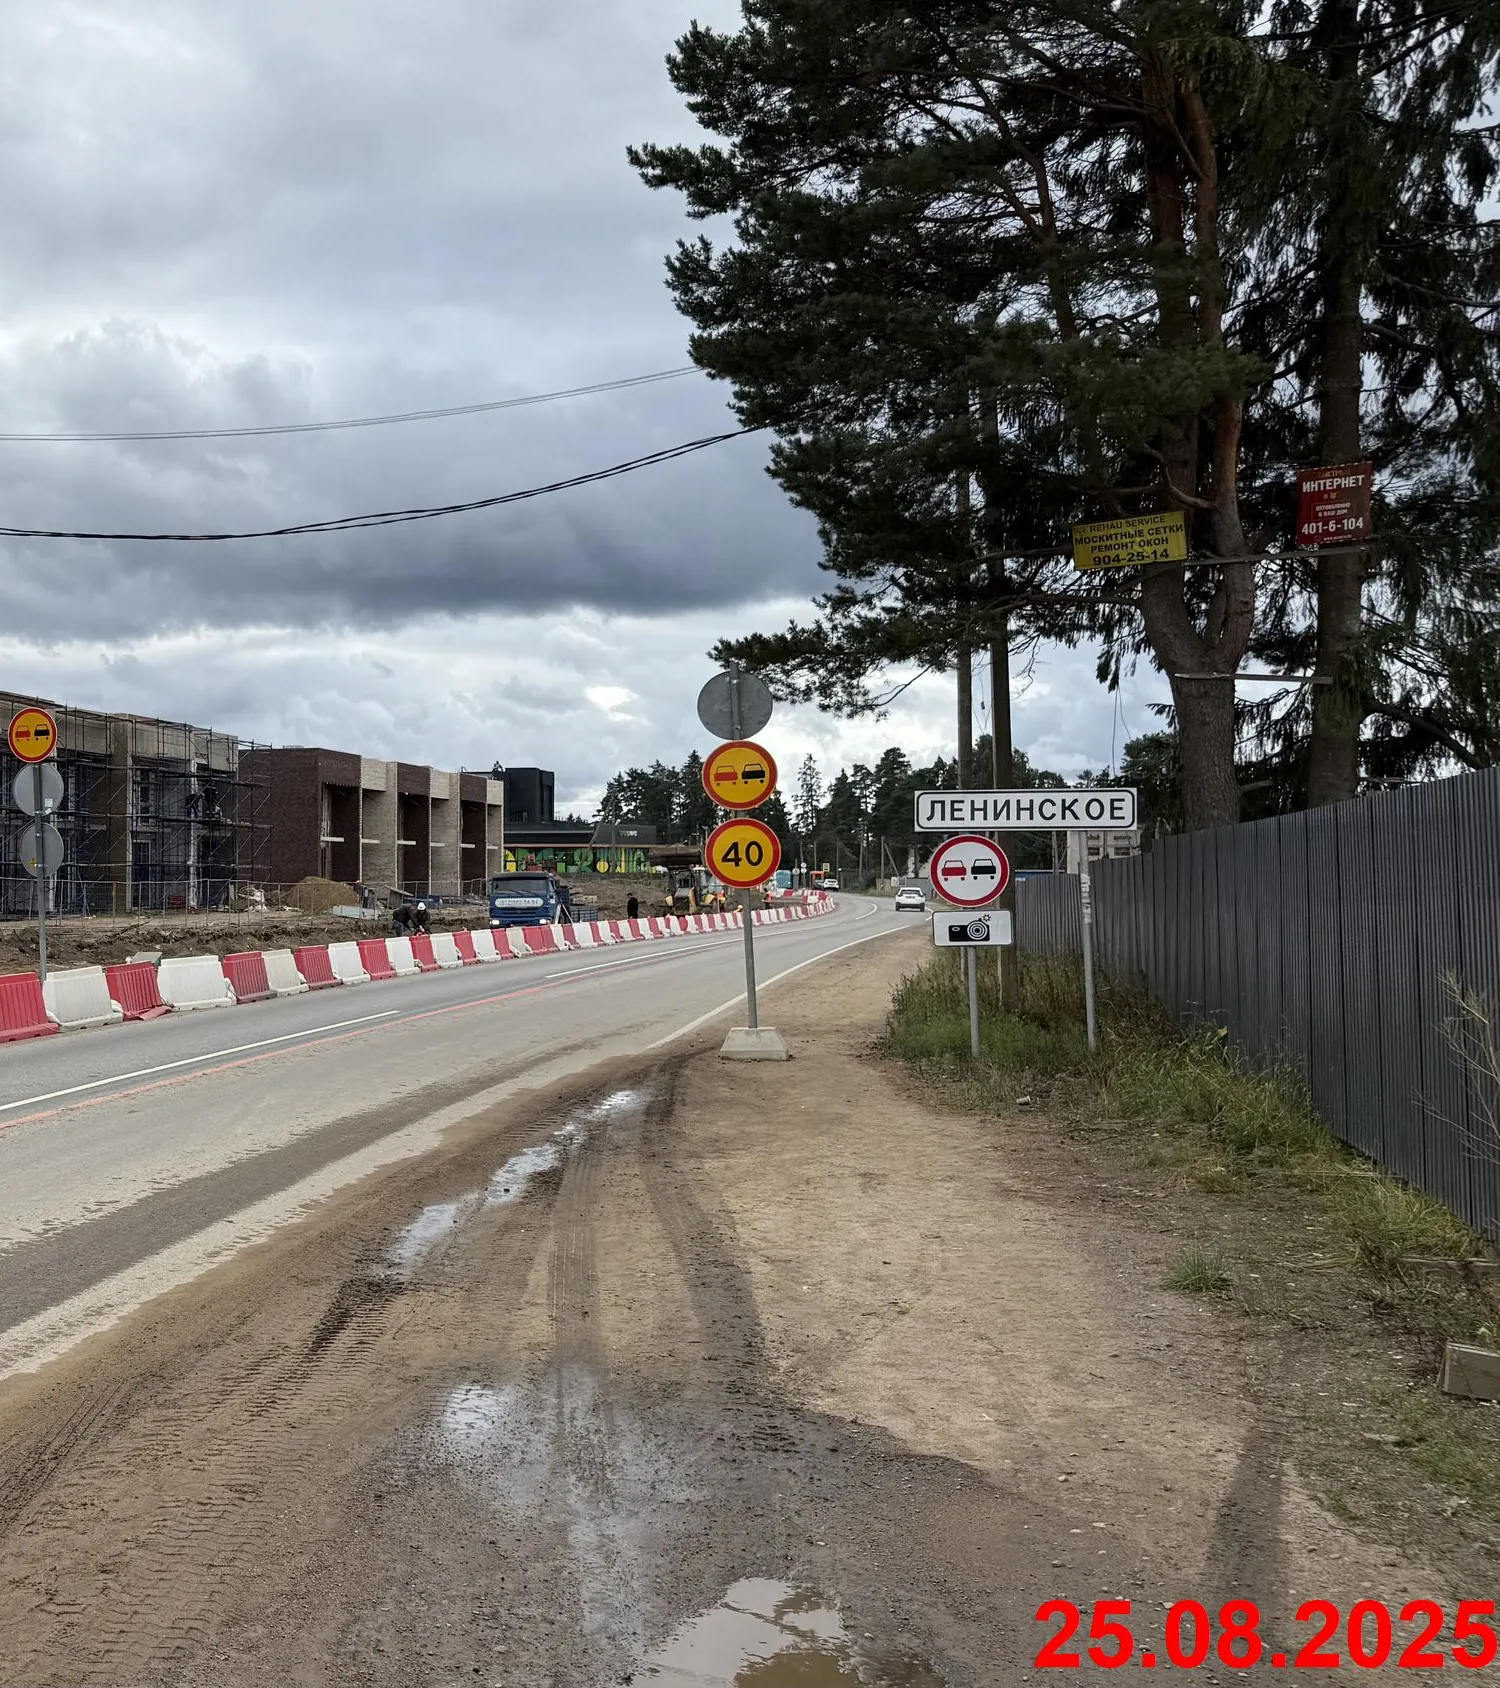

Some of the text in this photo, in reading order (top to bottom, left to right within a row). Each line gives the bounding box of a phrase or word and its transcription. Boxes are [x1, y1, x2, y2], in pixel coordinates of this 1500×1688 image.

[1302, 475, 1365, 493] ИНТЕРНЕТ
[1089, 522, 1122, 532] REHAU
[1125, 515, 1166, 528] SERVICE
[1301, 517, 1364, 535] 401-6-104
[1075, 530, 1145, 546] МОСКИТНЫЕ
[1148, 523, 1183, 536] СЕТКИ
[1091, 536, 1169, 554] РЕМОНТ ОКОН
[1092, 548, 1170, 566] 904-25-14
[926, 798, 1126, 822] ЛЕНИНСКОЕ
[721, 840, 764, 868] 40
